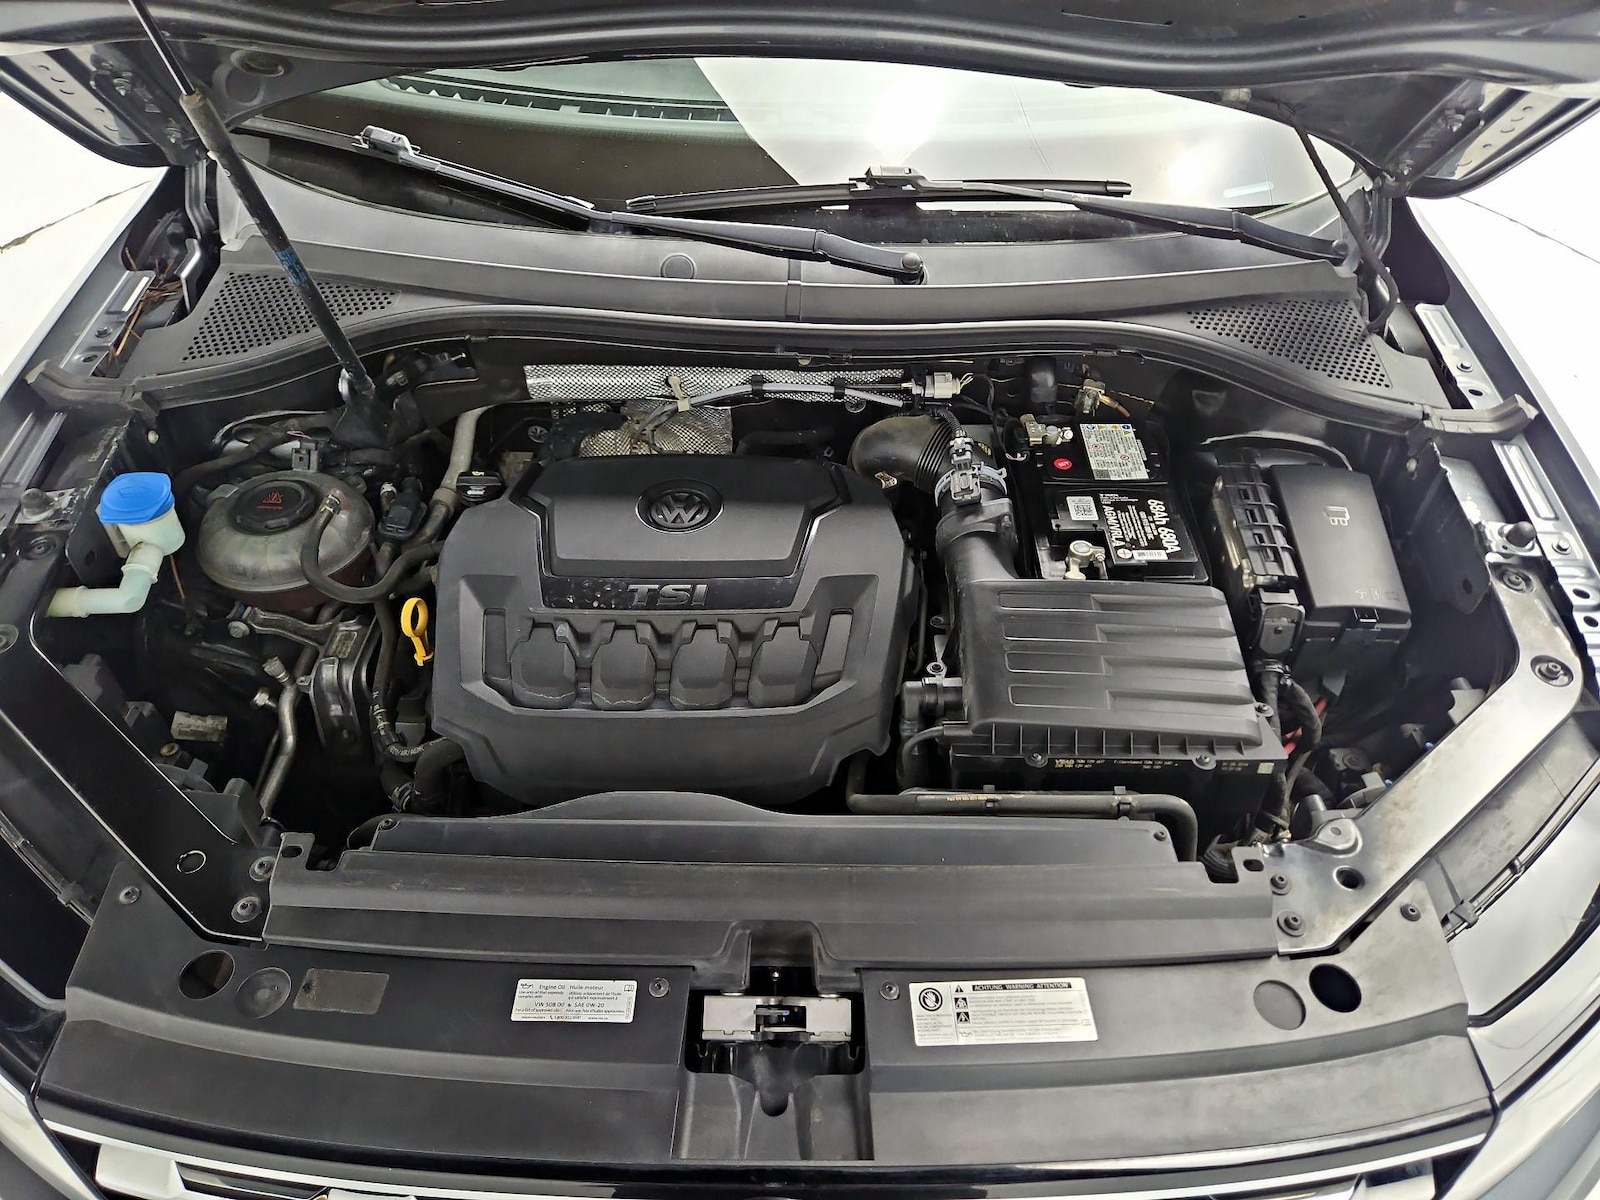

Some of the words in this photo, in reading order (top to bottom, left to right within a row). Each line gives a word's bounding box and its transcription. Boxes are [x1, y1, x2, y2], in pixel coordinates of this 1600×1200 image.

[1147, 498, 1170, 525] 68Ah
[1157, 526, 1182, 554] 680A
[627, 584, 709, 606] TSI
[974, 984, 1003, 992] ACHTUNG
[1037, 981, 1068, 989] ATTENTION
